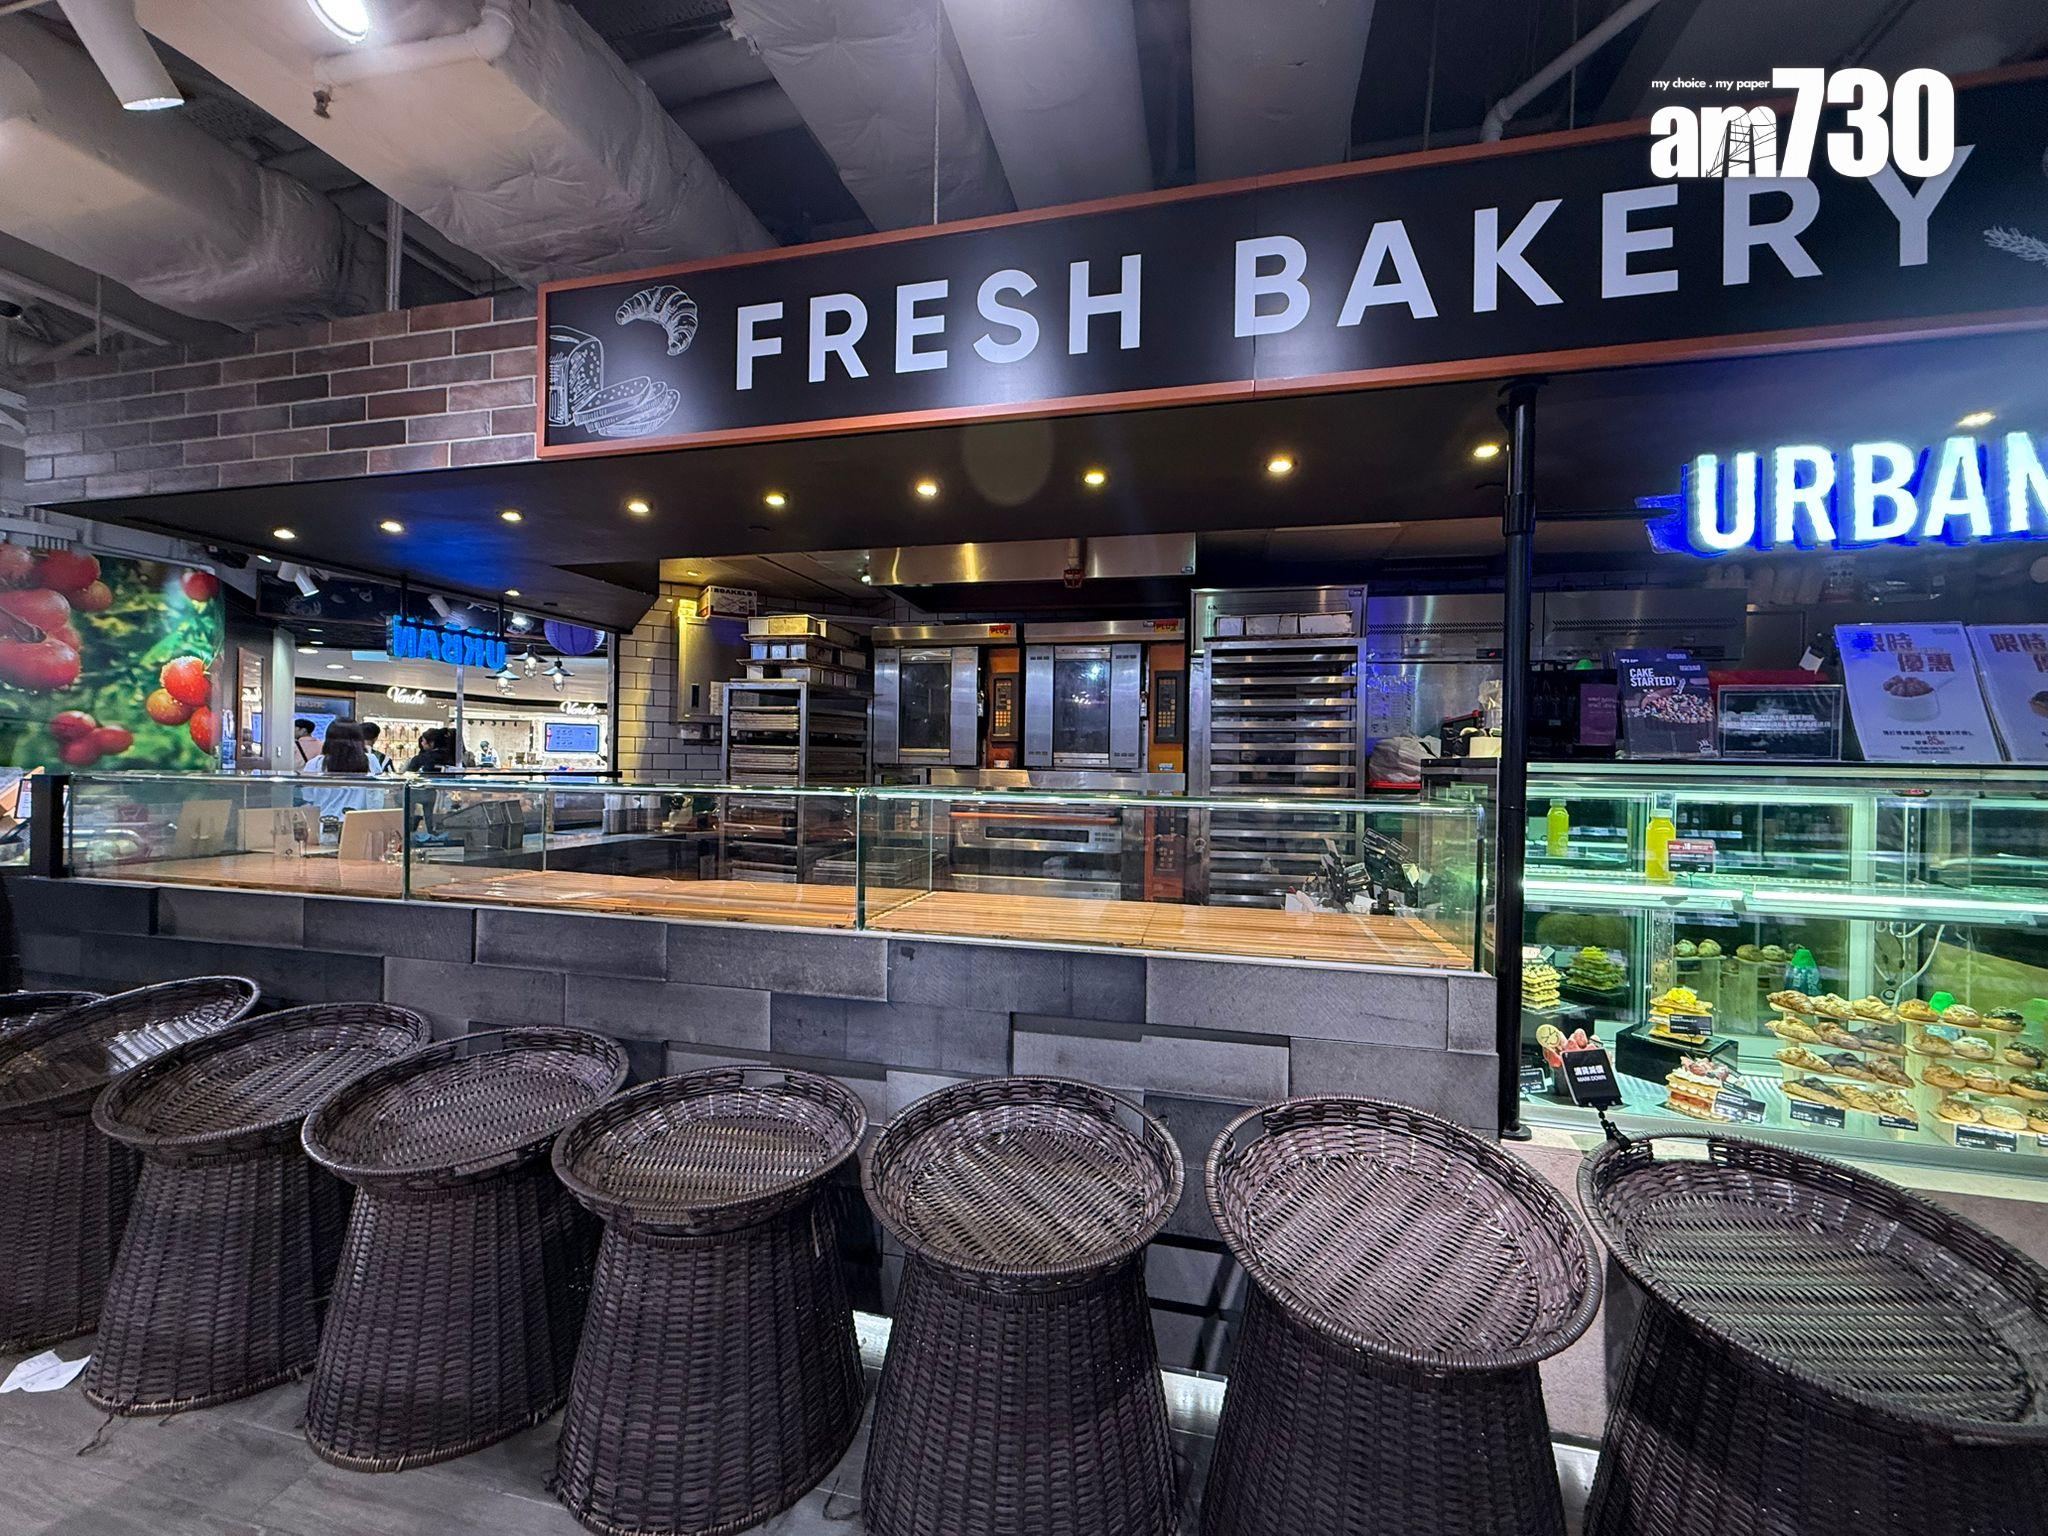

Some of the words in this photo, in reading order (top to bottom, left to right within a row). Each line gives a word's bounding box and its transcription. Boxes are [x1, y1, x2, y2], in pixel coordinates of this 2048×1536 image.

[736, 254, 1142, 391] FRESH
[1234, 144, 1976, 338] BAKERY
[1629, 668, 1654, 678] CAKE
[1630, 676, 1676, 687] STARTED!
[387, 686, 426, 704] Venchi
[560, 701, 598, 715] Venchi
